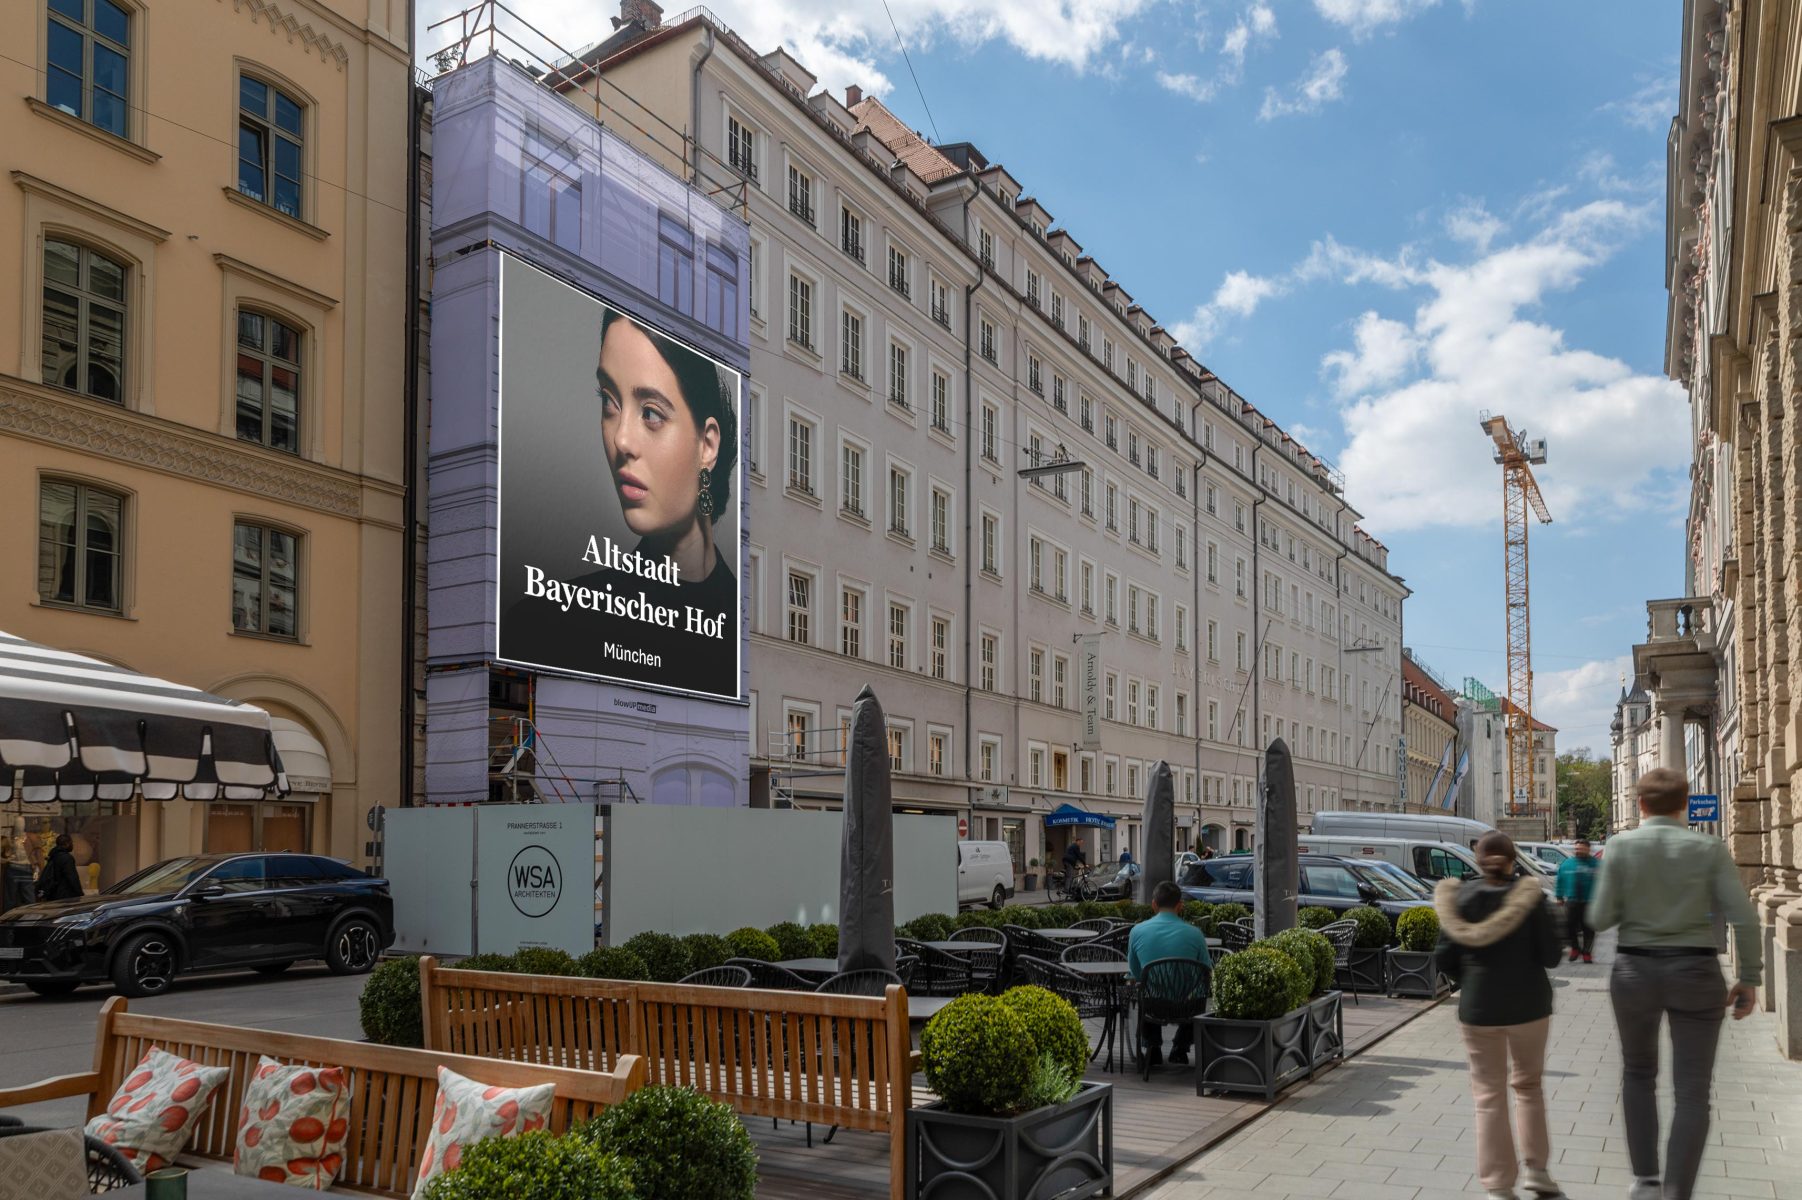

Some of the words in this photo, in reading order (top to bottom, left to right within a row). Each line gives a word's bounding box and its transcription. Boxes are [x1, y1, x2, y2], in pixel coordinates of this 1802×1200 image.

[582, 534, 681, 587] Altstadt
[524, 564, 679, 628] Bayerischer
[684, 605, 726, 640] Hof
[604, 641, 662, 667] München
[1085, 652, 1097, 692] Arnoldy
[1087, 696, 1096, 705] &
[1087, 708, 1096, 735] Team
[507, 821, 557, 830] PRANNERSTRASSE
[515, 865, 556, 889] WSA
[514, 890, 556, 898] ARCHITEKTEN
